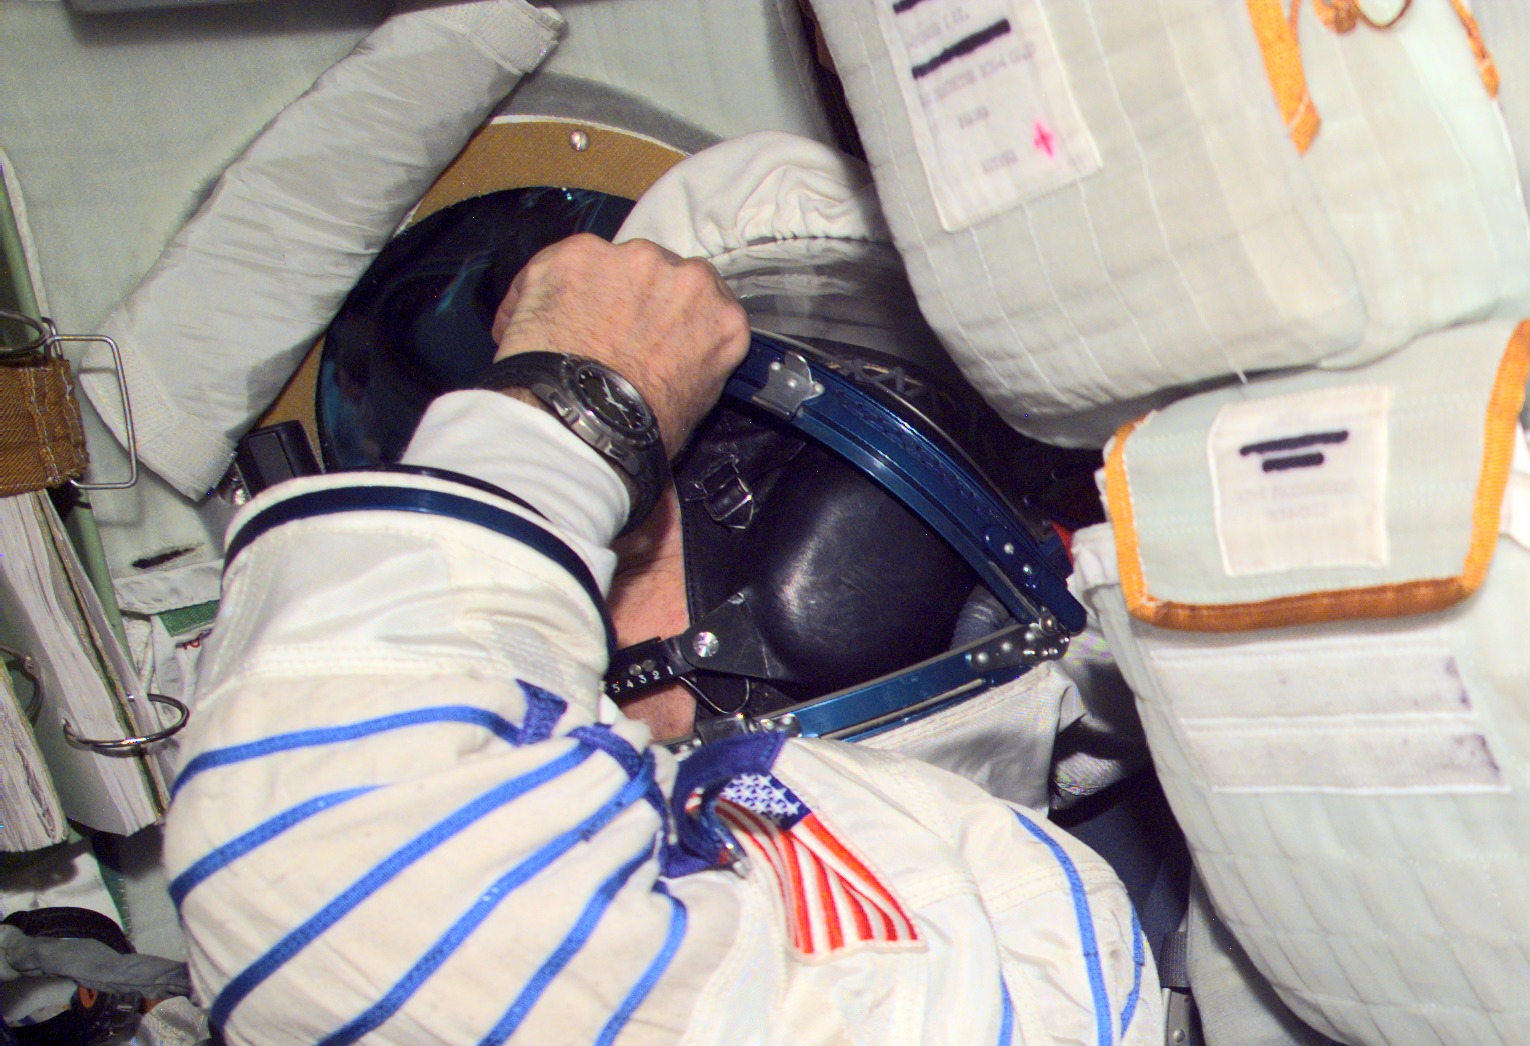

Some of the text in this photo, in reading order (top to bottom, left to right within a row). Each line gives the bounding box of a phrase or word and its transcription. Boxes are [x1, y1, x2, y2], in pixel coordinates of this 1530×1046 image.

[612, 665, 674, 693] 5 4 3 2 1
